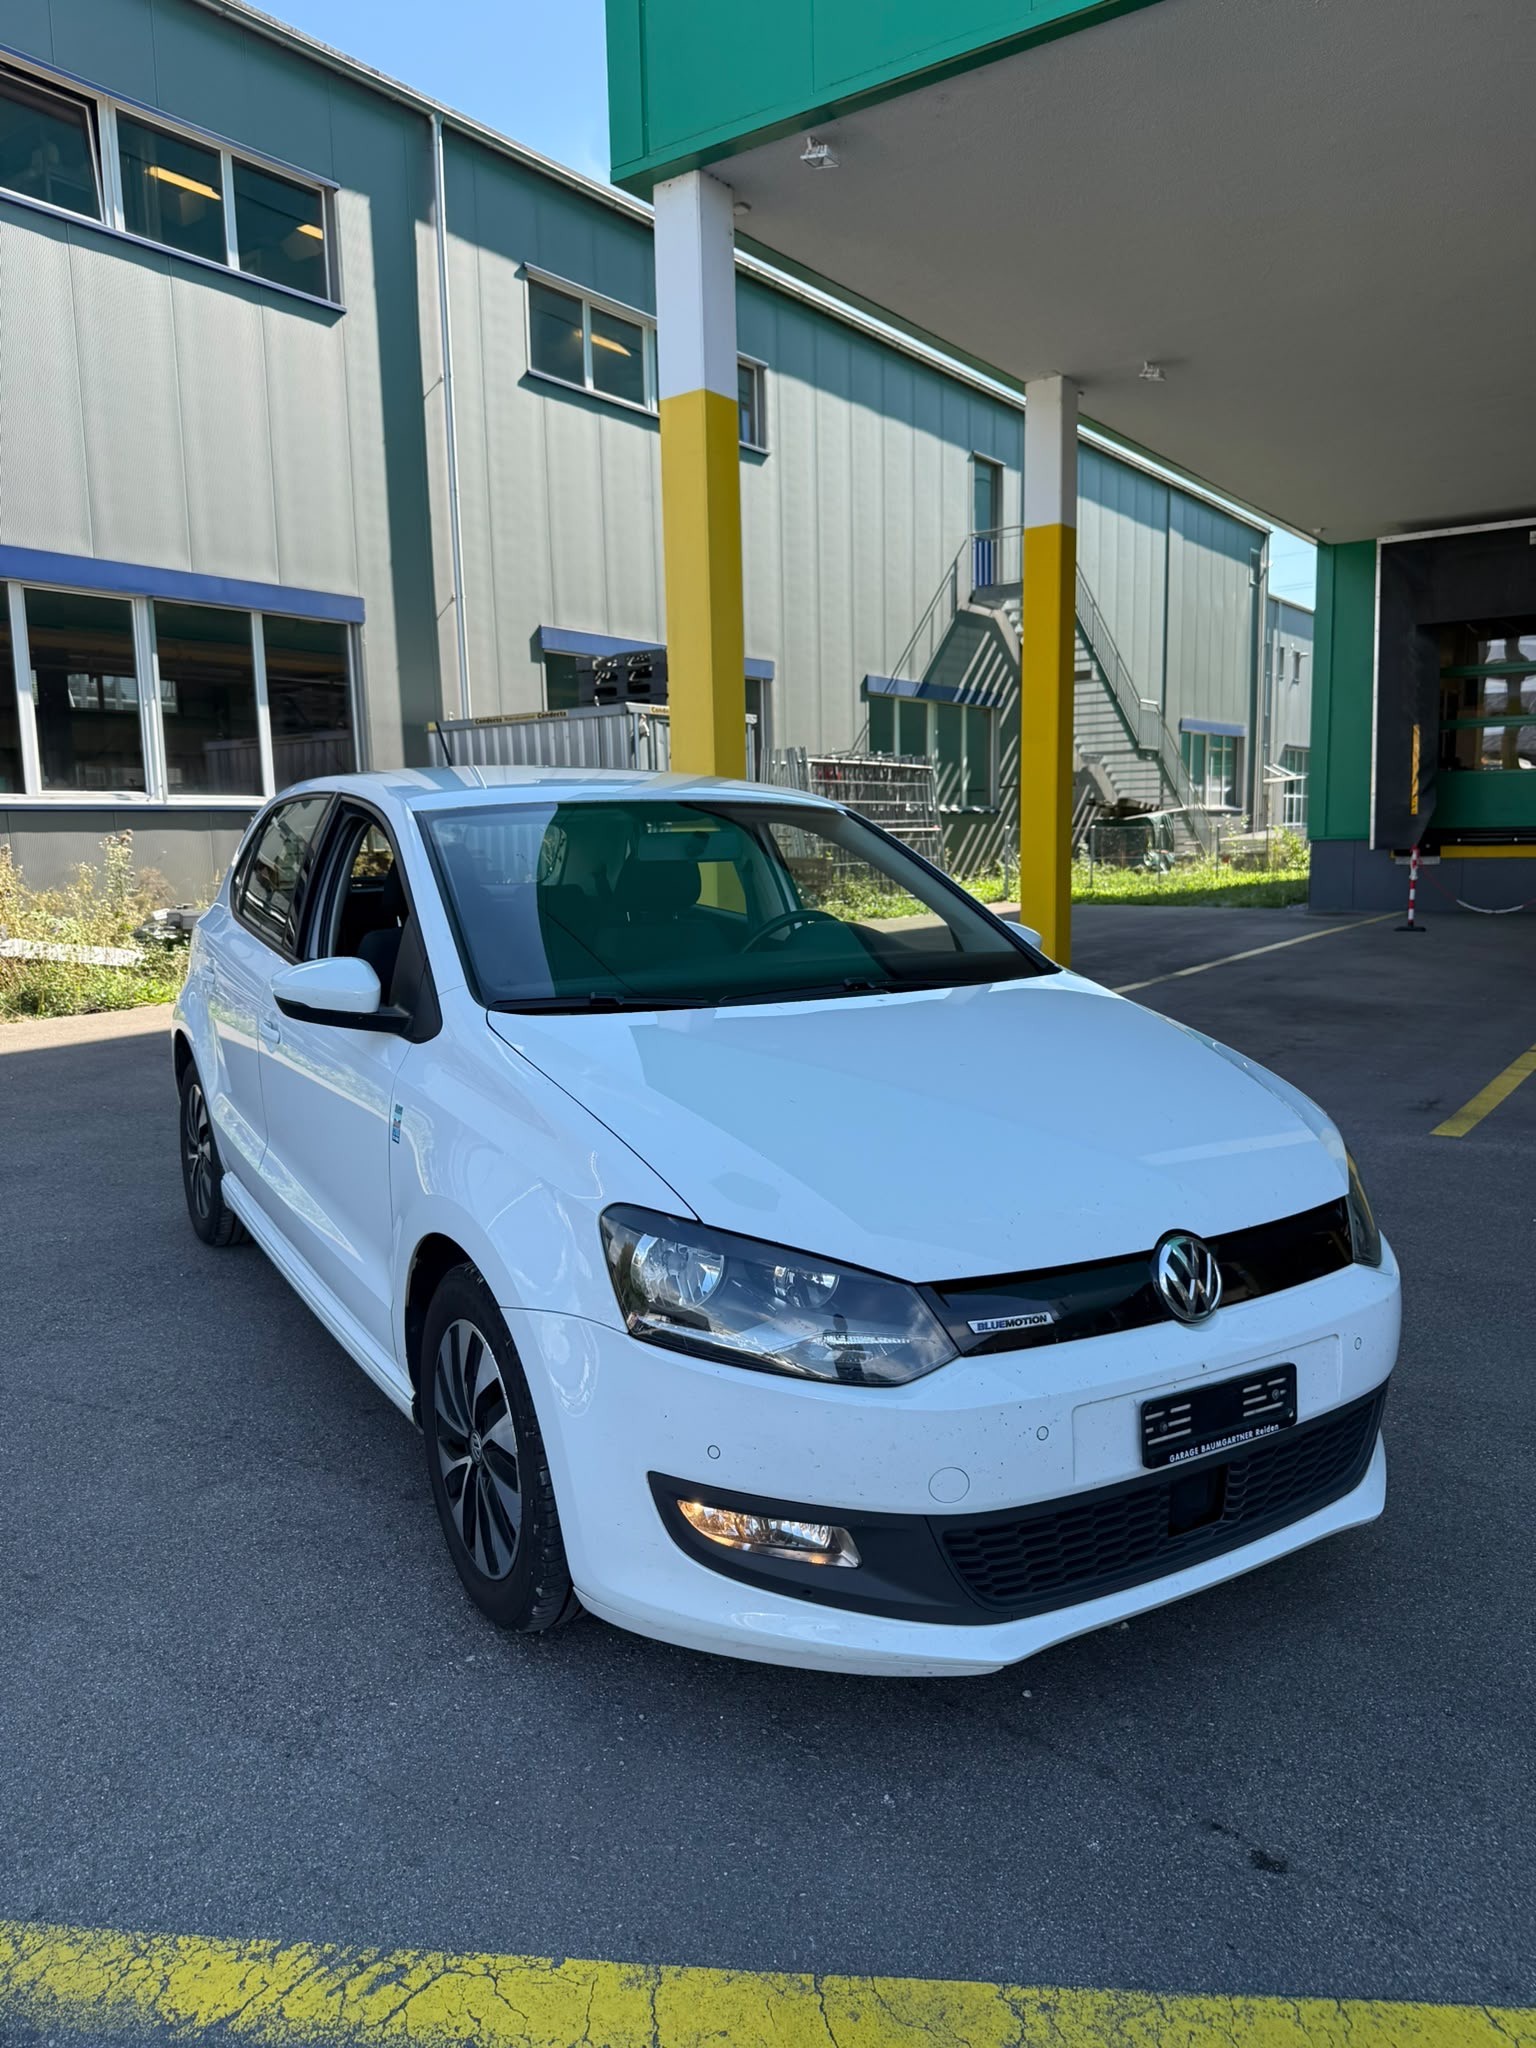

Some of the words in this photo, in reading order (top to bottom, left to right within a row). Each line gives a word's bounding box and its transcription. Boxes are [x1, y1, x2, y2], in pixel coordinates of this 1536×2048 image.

[1159, 1236, 1221, 1322] VW
[977, 1315, 1047, 1331] BLUEMOTION
[1169, 1448, 1199, 1463] GARAGE
[1201, 1431, 1253, 1453] BAUMGARTNER
[1255, 1424, 1279, 1436] Reiden
